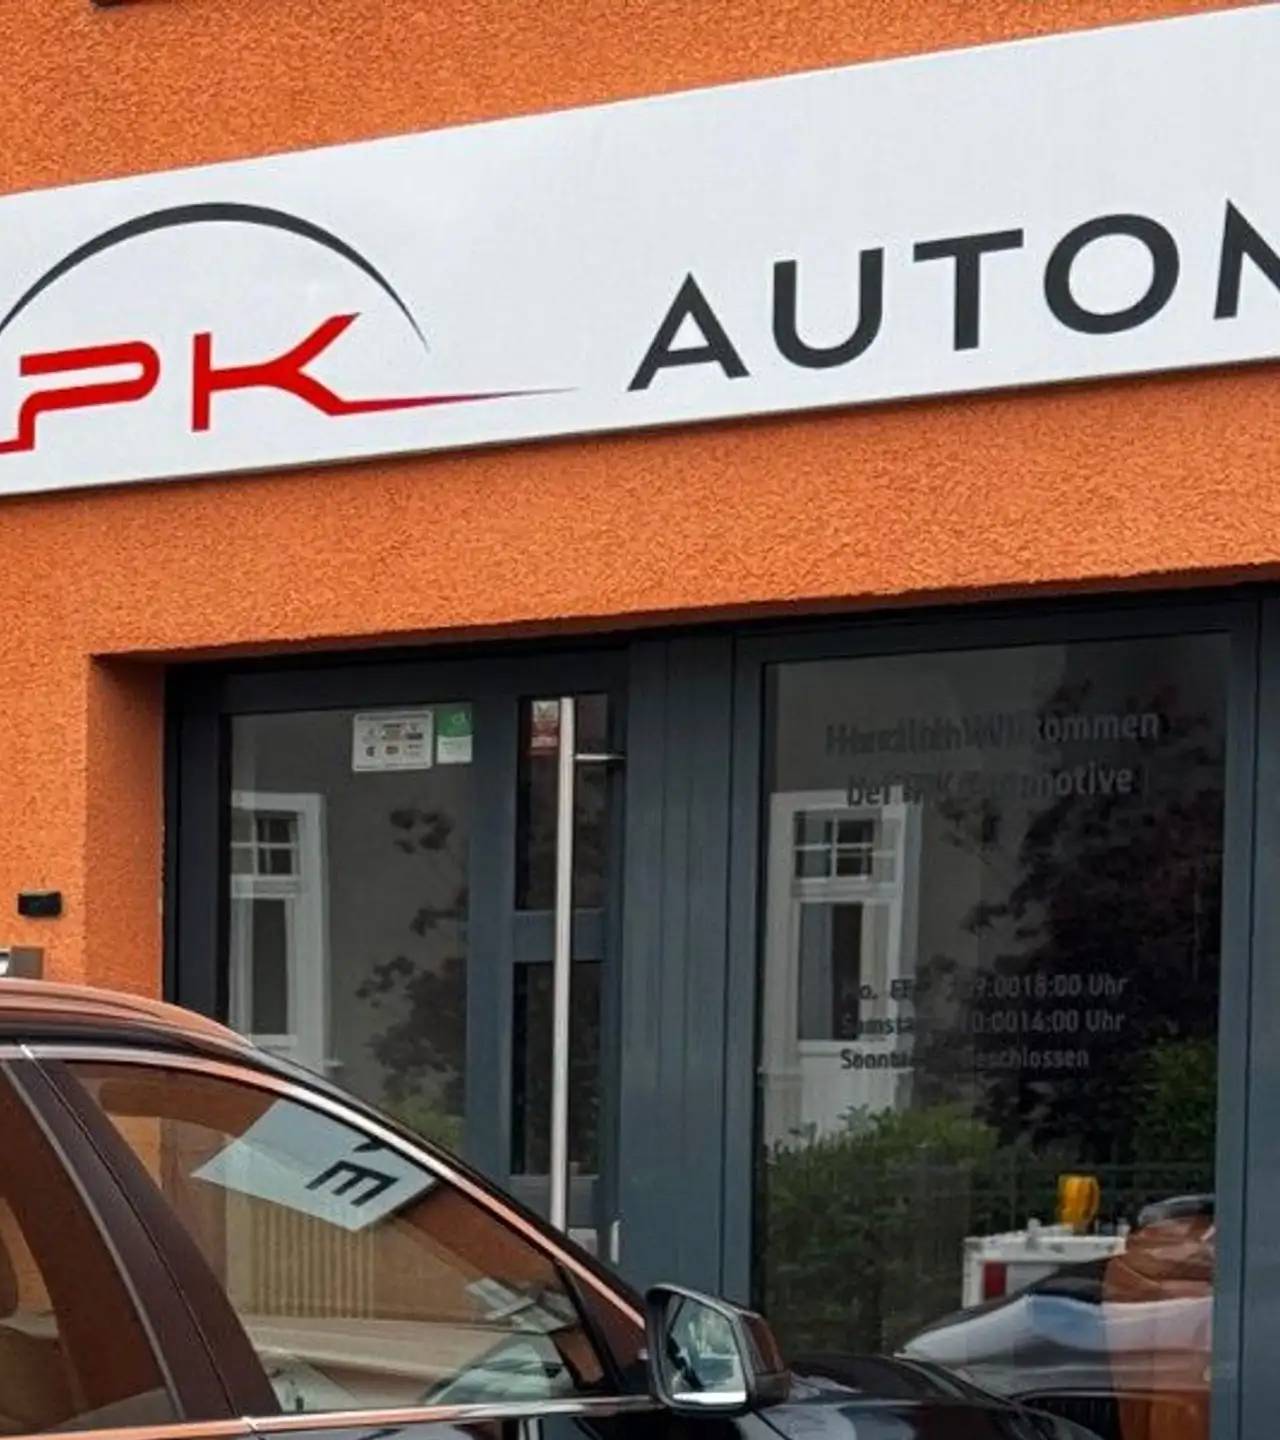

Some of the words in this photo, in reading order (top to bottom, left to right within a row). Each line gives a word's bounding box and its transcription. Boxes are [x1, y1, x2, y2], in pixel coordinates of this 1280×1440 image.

[18, 310, 362, 454] PK
[1089, 972, 1129, 997] Uhr
[1085, 1008, 1126, 1033] Uhr
